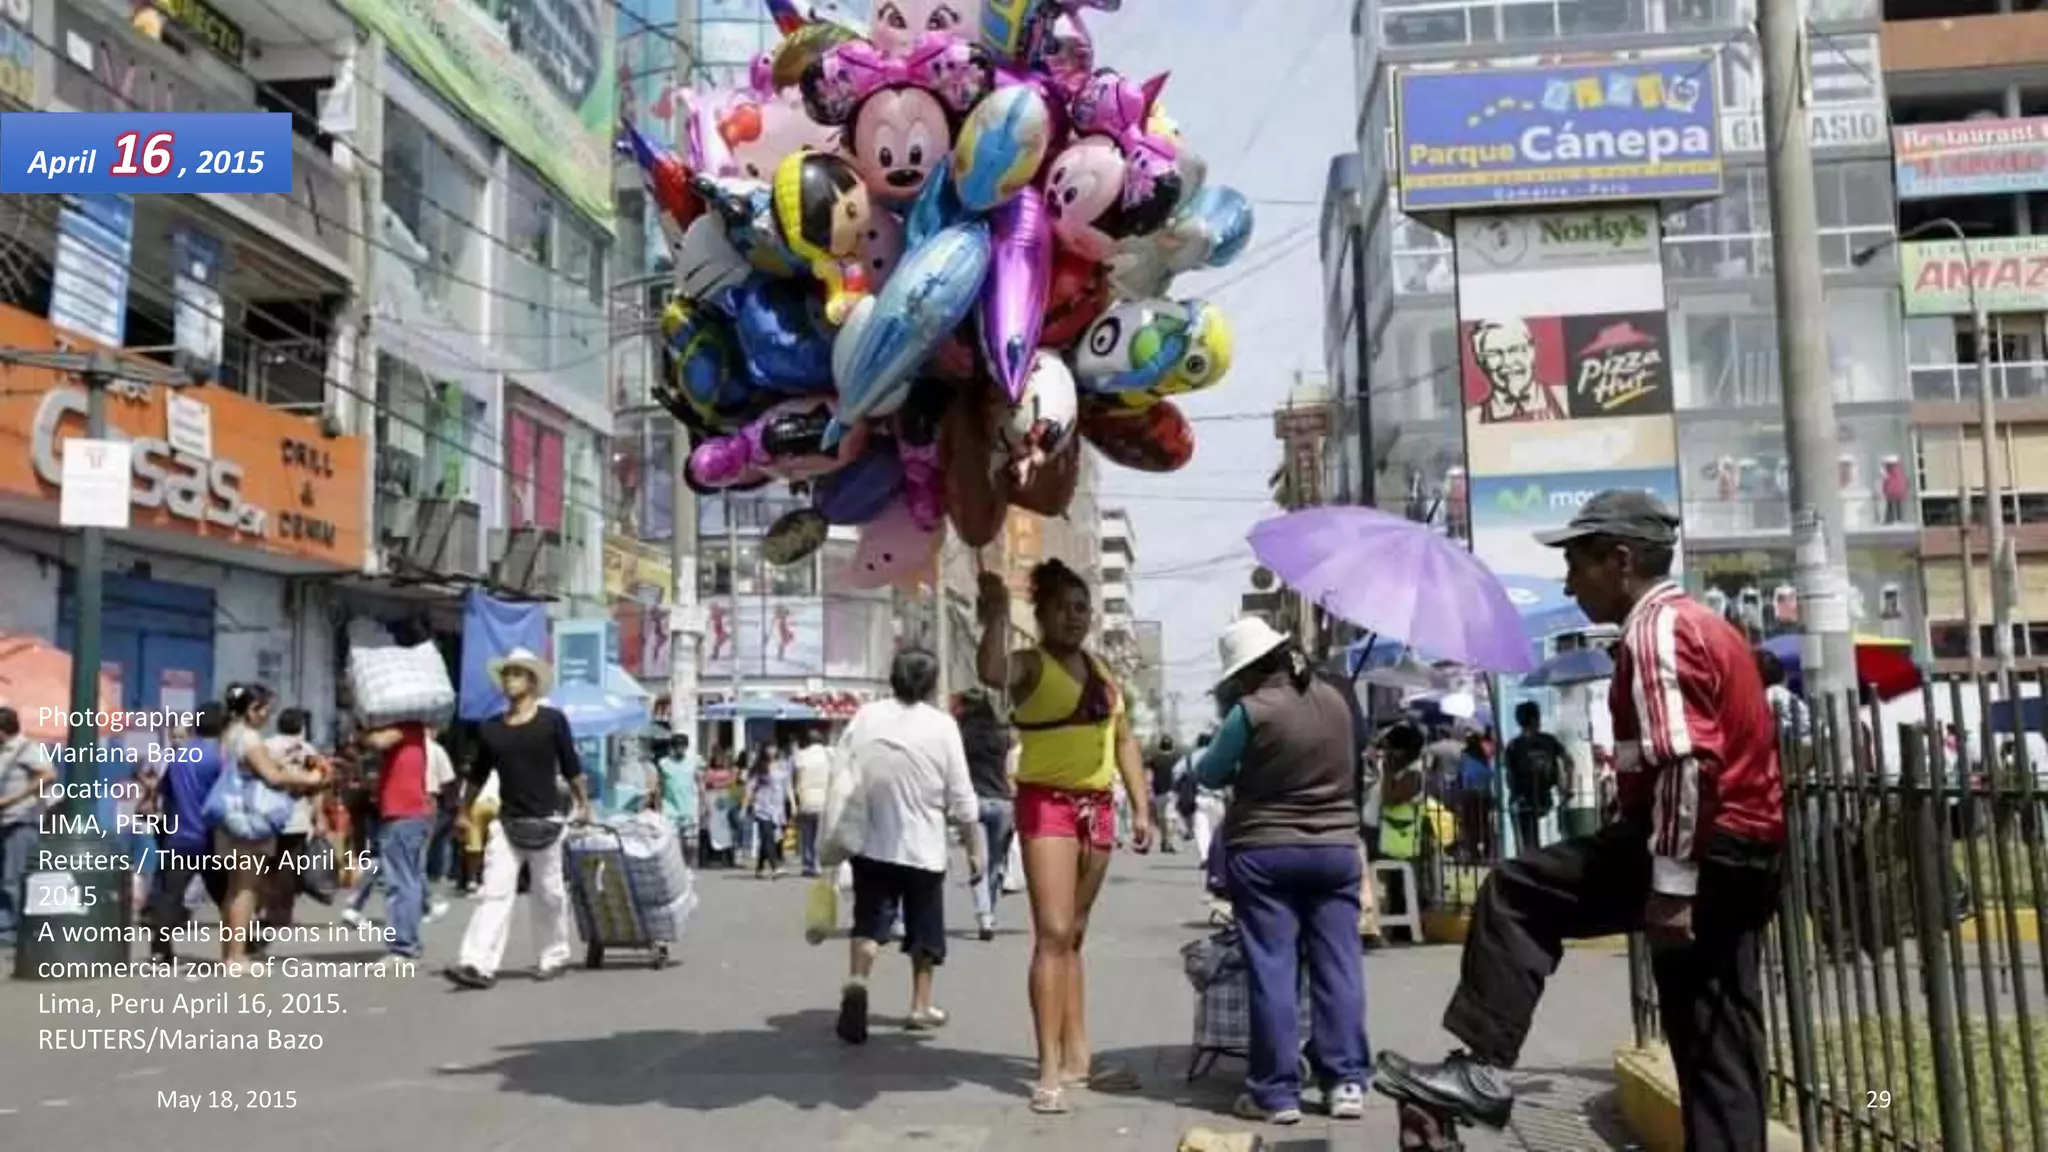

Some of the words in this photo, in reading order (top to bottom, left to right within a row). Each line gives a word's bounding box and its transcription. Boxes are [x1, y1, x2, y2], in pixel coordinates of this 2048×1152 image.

[1409, 141, 1515, 167] Parque
[1520, 121, 1710, 163] Cánepa
[1732, 112, 1878, 145] GIASIO
[1904, 122, 2034, 147] Restaurant
[1541, 214, 1648, 247] Norky's
[1577, 349, 1662, 394] Pizza
[1592, 369, 1657, 402] Hut
[32, 386, 248, 528] Csas
